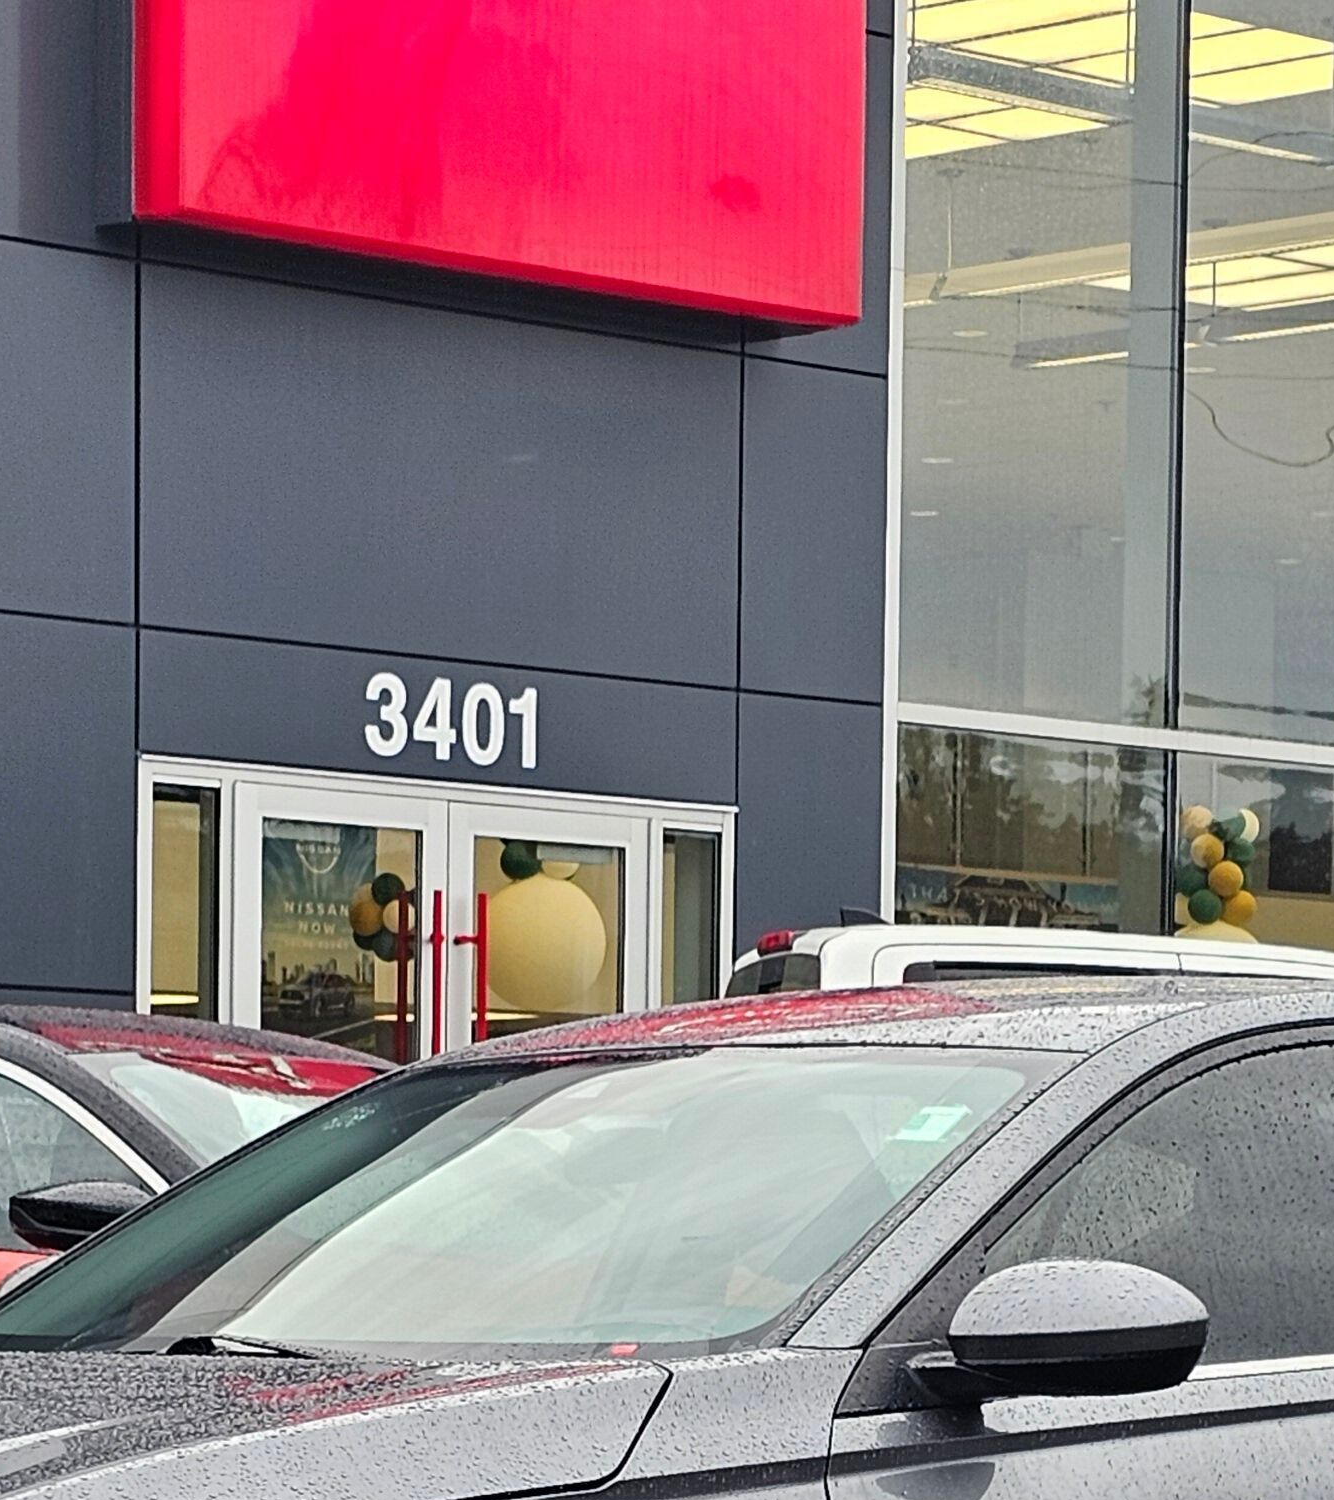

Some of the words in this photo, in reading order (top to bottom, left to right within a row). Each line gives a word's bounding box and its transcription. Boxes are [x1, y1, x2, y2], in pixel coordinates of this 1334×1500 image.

[364, 671, 538, 769] 3401
[283, 901, 349, 917] NISSAN
[298, 920, 337, 936] NOW
